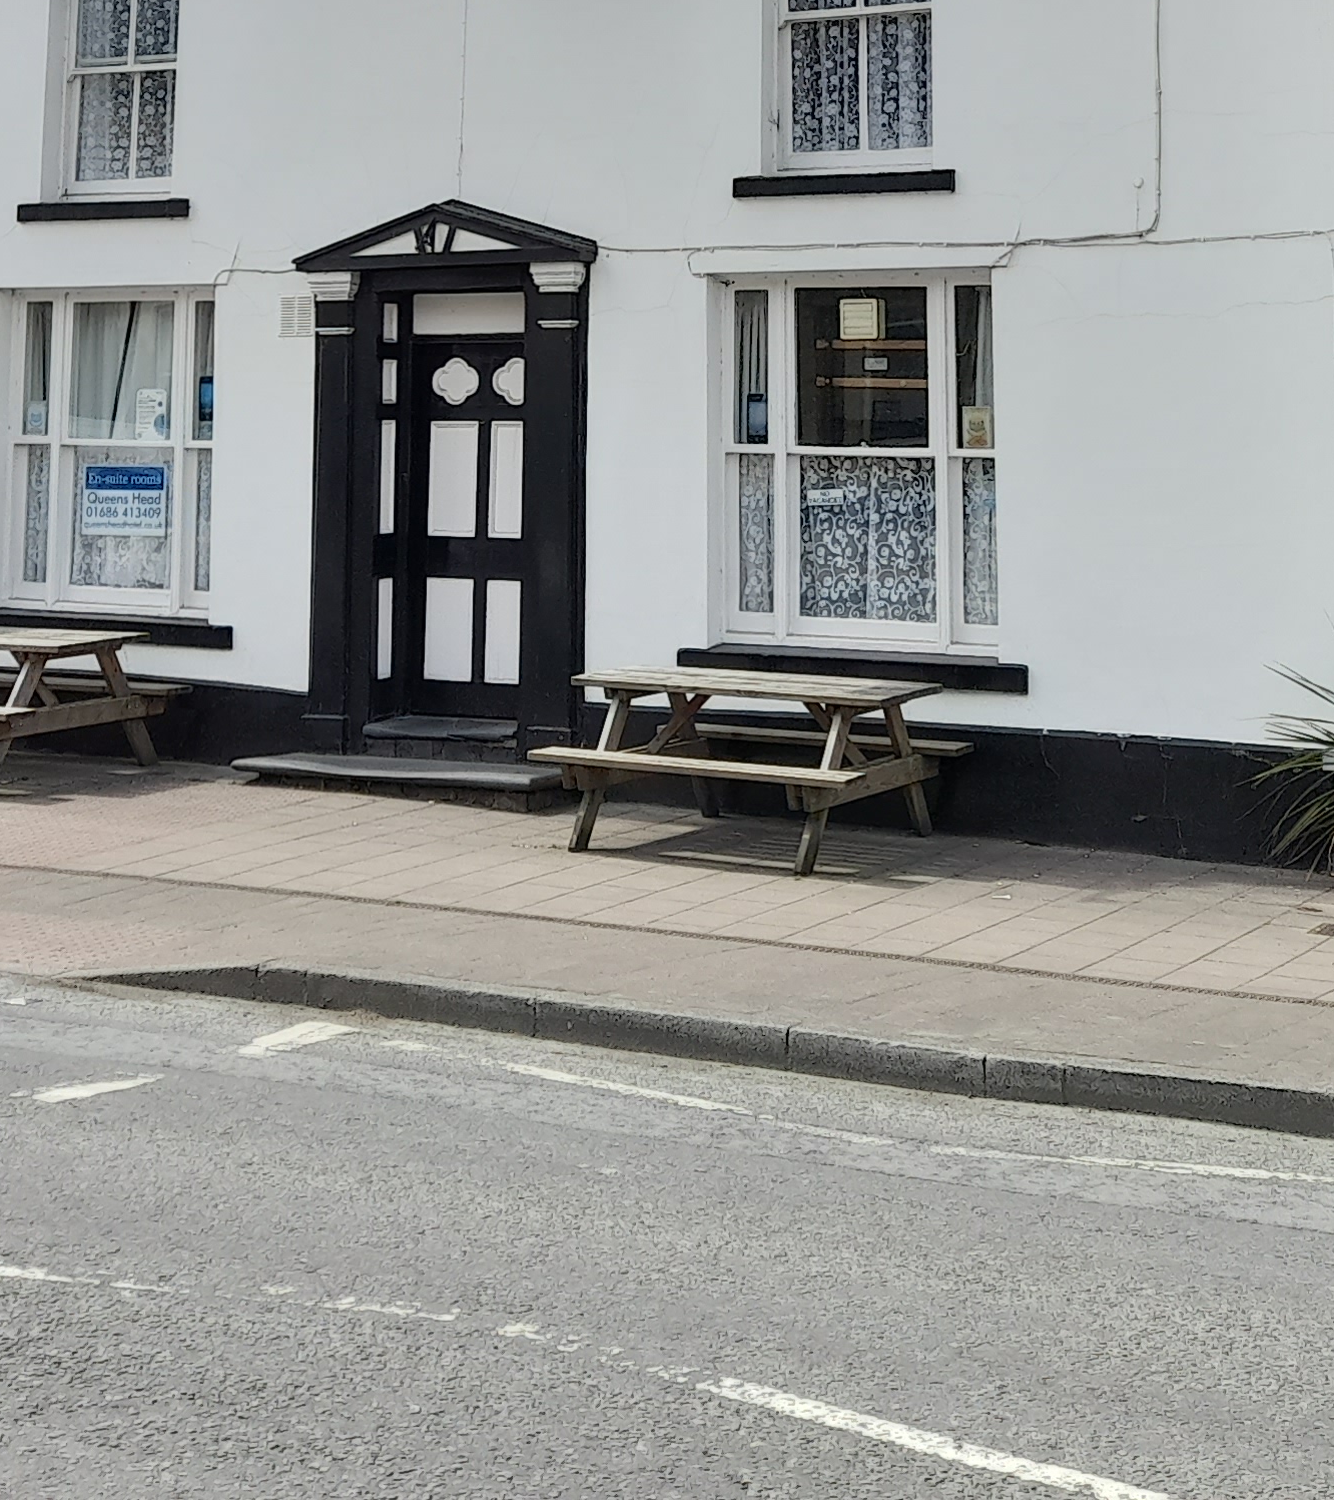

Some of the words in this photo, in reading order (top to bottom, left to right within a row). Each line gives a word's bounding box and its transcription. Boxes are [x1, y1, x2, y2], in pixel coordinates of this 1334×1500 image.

[88, 473, 129, 485] En-suite
[130, 474, 161, 485] rooms
[87, 492, 128, 505] Queens
[132, 493, 161, 505] Head
[86, 506, 118, 518] 01686
[122, 506, 162, 518] 413409
